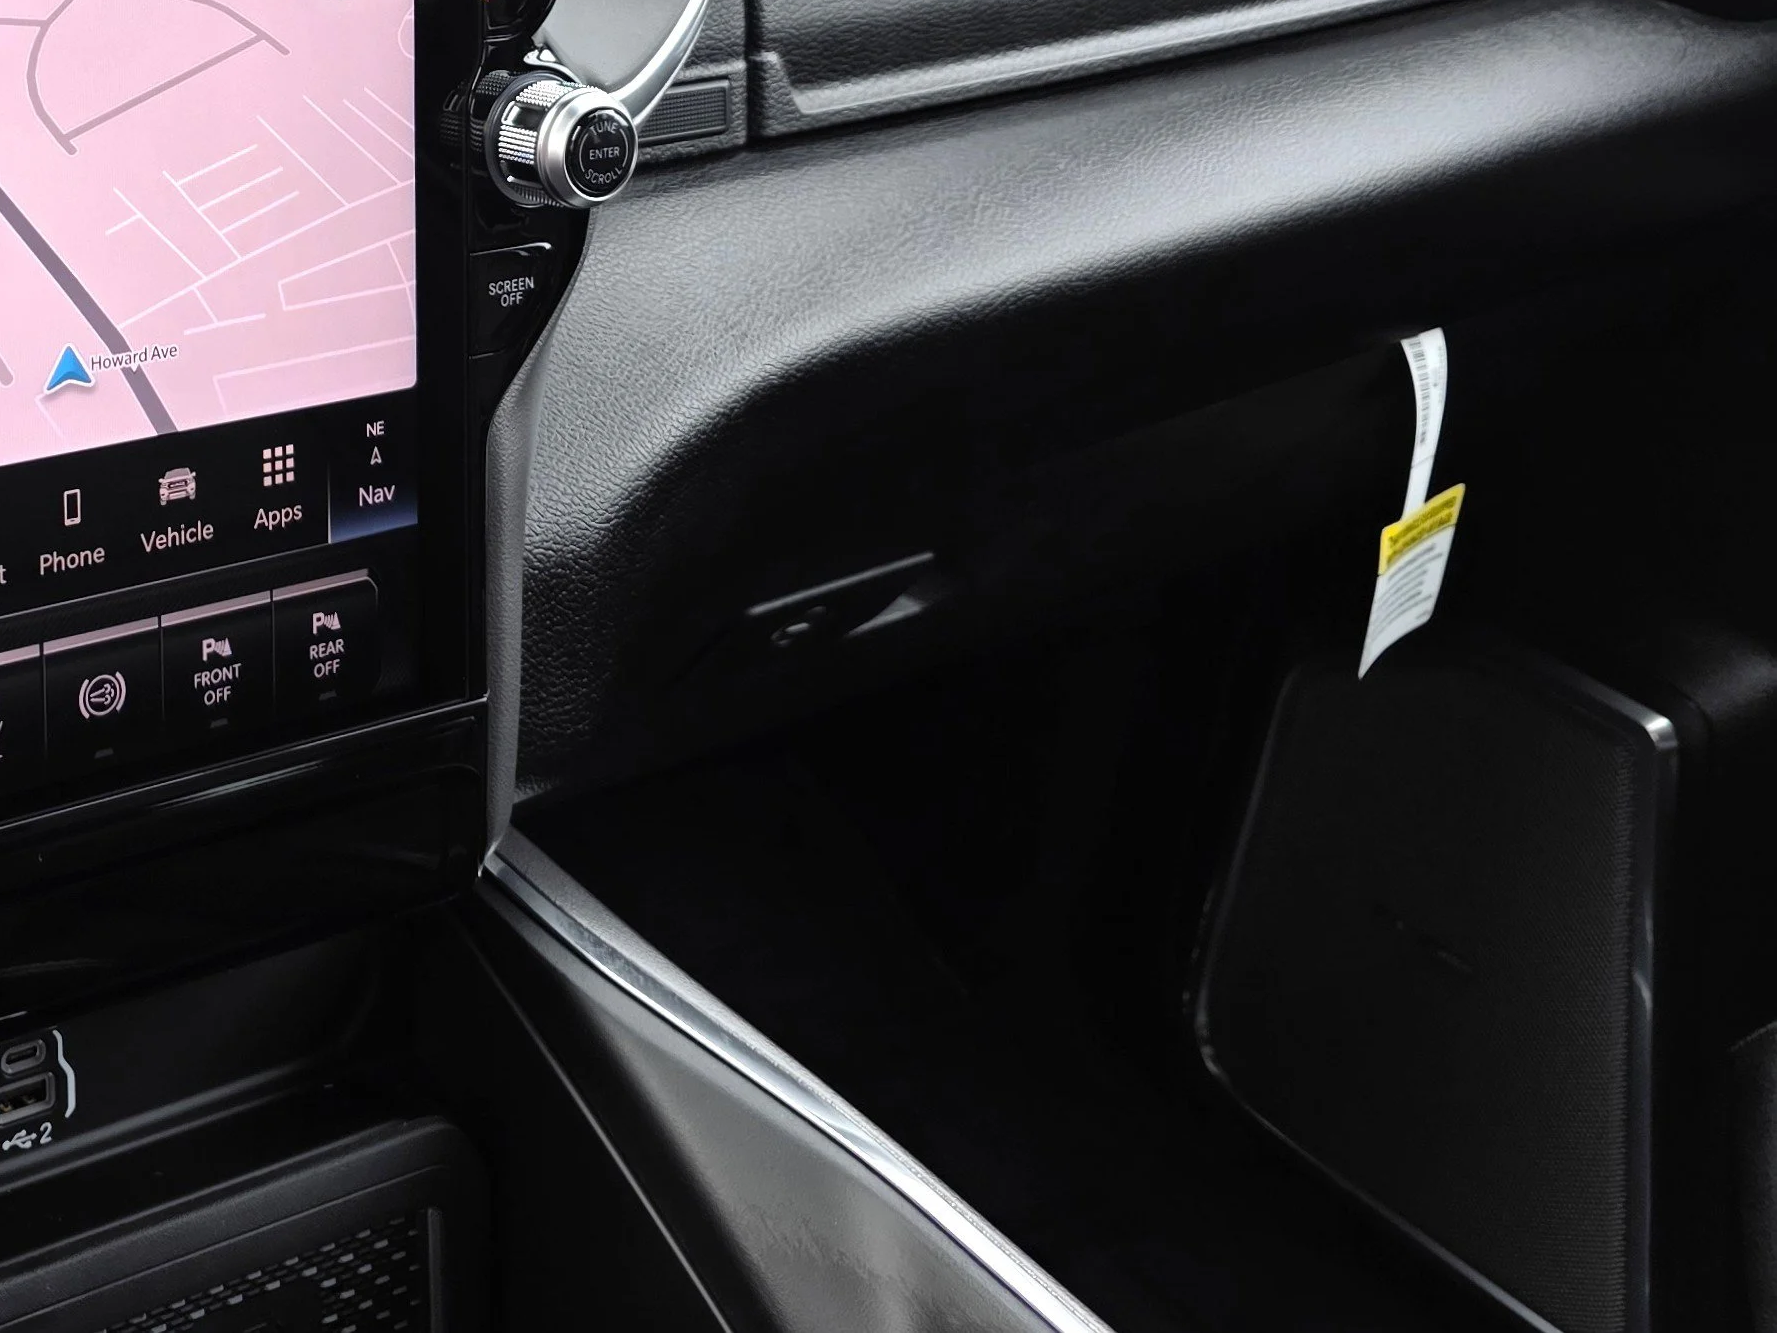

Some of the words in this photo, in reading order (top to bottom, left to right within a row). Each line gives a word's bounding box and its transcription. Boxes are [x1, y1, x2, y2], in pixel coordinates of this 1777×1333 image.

[590, 123, 618, 135] TUNE
[590, 147, 620, 159] ENTER
[585, 167, 622, 185] SCROLL
[489, 277, 534, 296] SCREEN
[501, 293, 522, 307] OFF
[90, 347, 148, 372] Howard
[150, 344, 178, 363] Ave
[366, 421, 384, 437] NE
[358, 482, 396, 507] Nav
[253, 501, 303, 532] Apps
[140, 520, 214, 553] Vehicle
[40, 543, 106, 576] Phone
[309, 637, 345, 661] REAR
[193, 663, 242, 690] FRONT
[313, 658, 341, 678] OFF
[203, 685, 232, 706] OFF
[40, 1121, 52, 1144] 2
